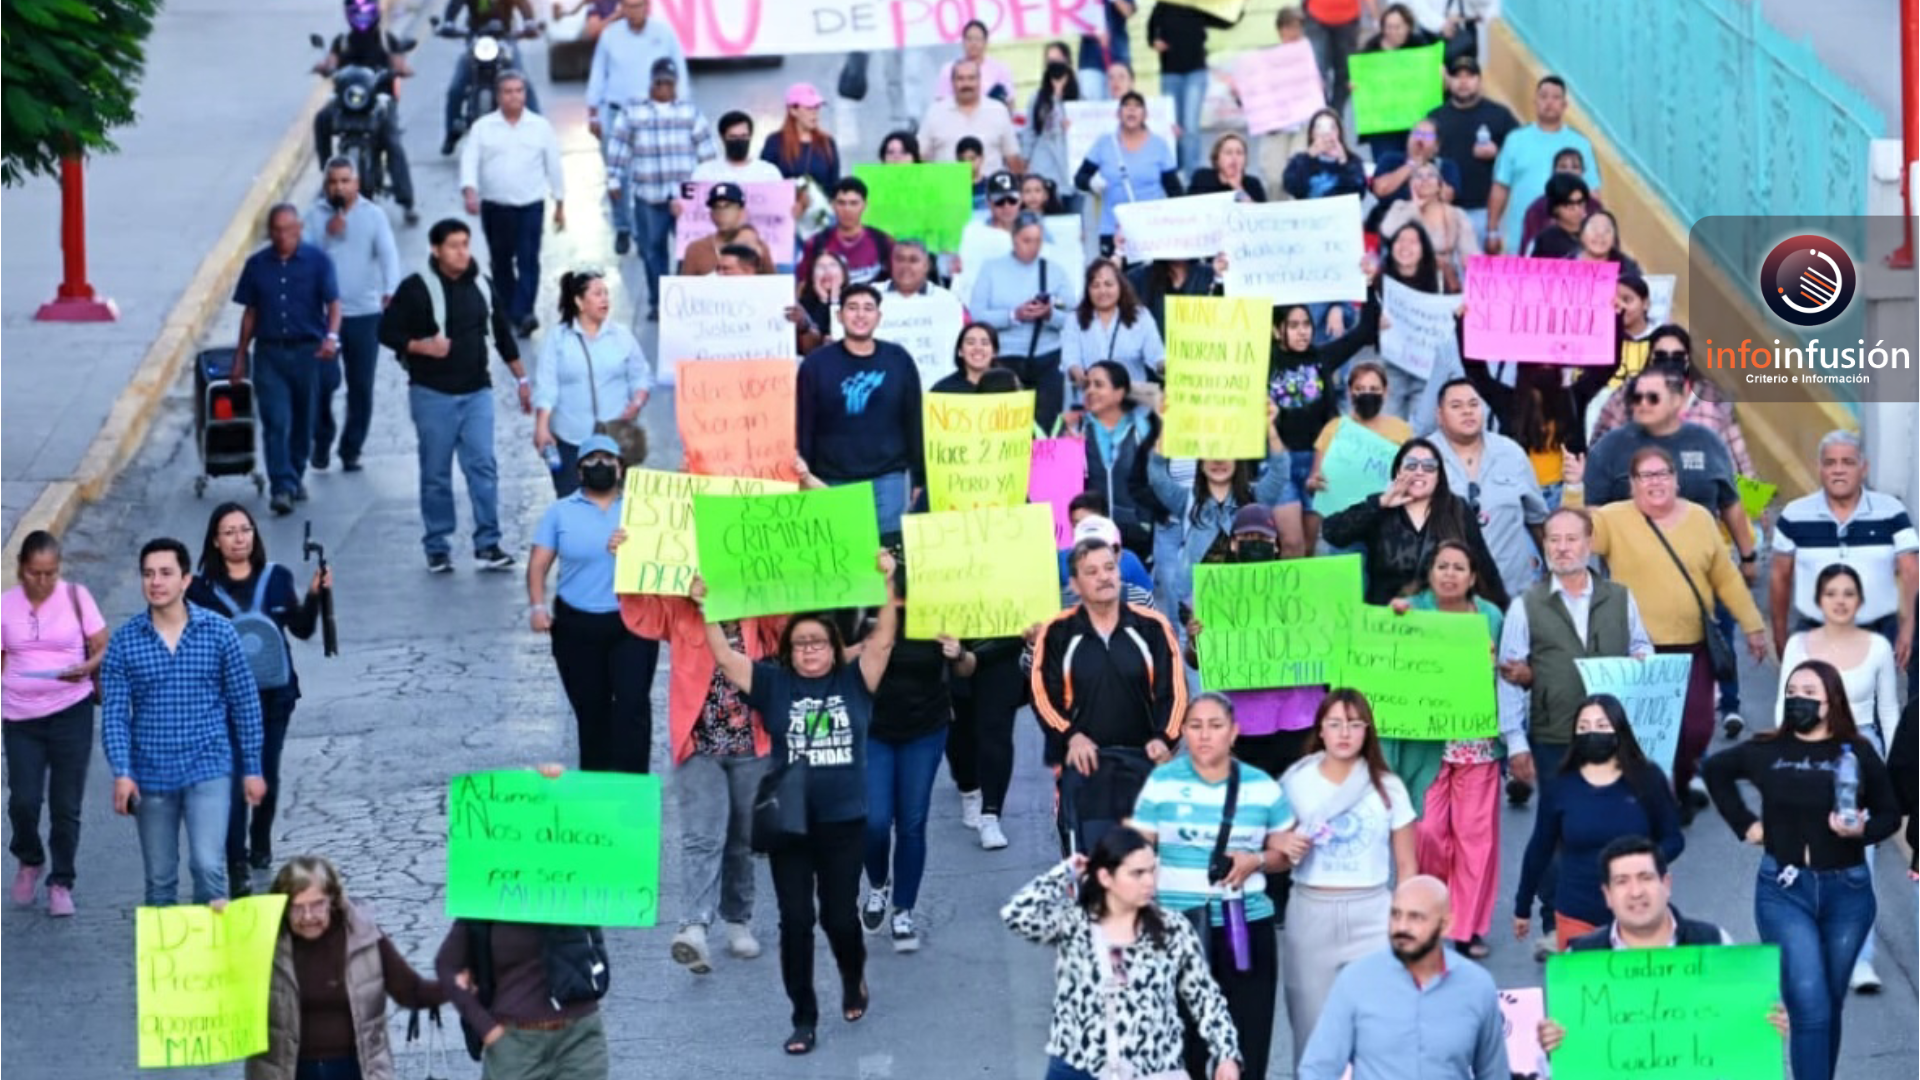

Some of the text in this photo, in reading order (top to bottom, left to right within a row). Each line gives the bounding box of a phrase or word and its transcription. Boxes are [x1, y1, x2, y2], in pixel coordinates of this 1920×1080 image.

[812, 4, 878, 35] DE
[888, 0, 1098, 46] PODER
[978, 438, 999, 464] 2
[722, 517, 837, 558] CRIMINAL
[739, 543, 852, 582] POR SER
[1263, 594, 1318, 626] NOS
[1347, 636, 1445, 674] hombres
[1427, 713, 1498, 737] ARTURO
[1606, 950, 1677, 980] Cuidar
[1580, 982, 1687, 1028] Maestro
[1606, 1028, 1715, 1072] Cuidar la
